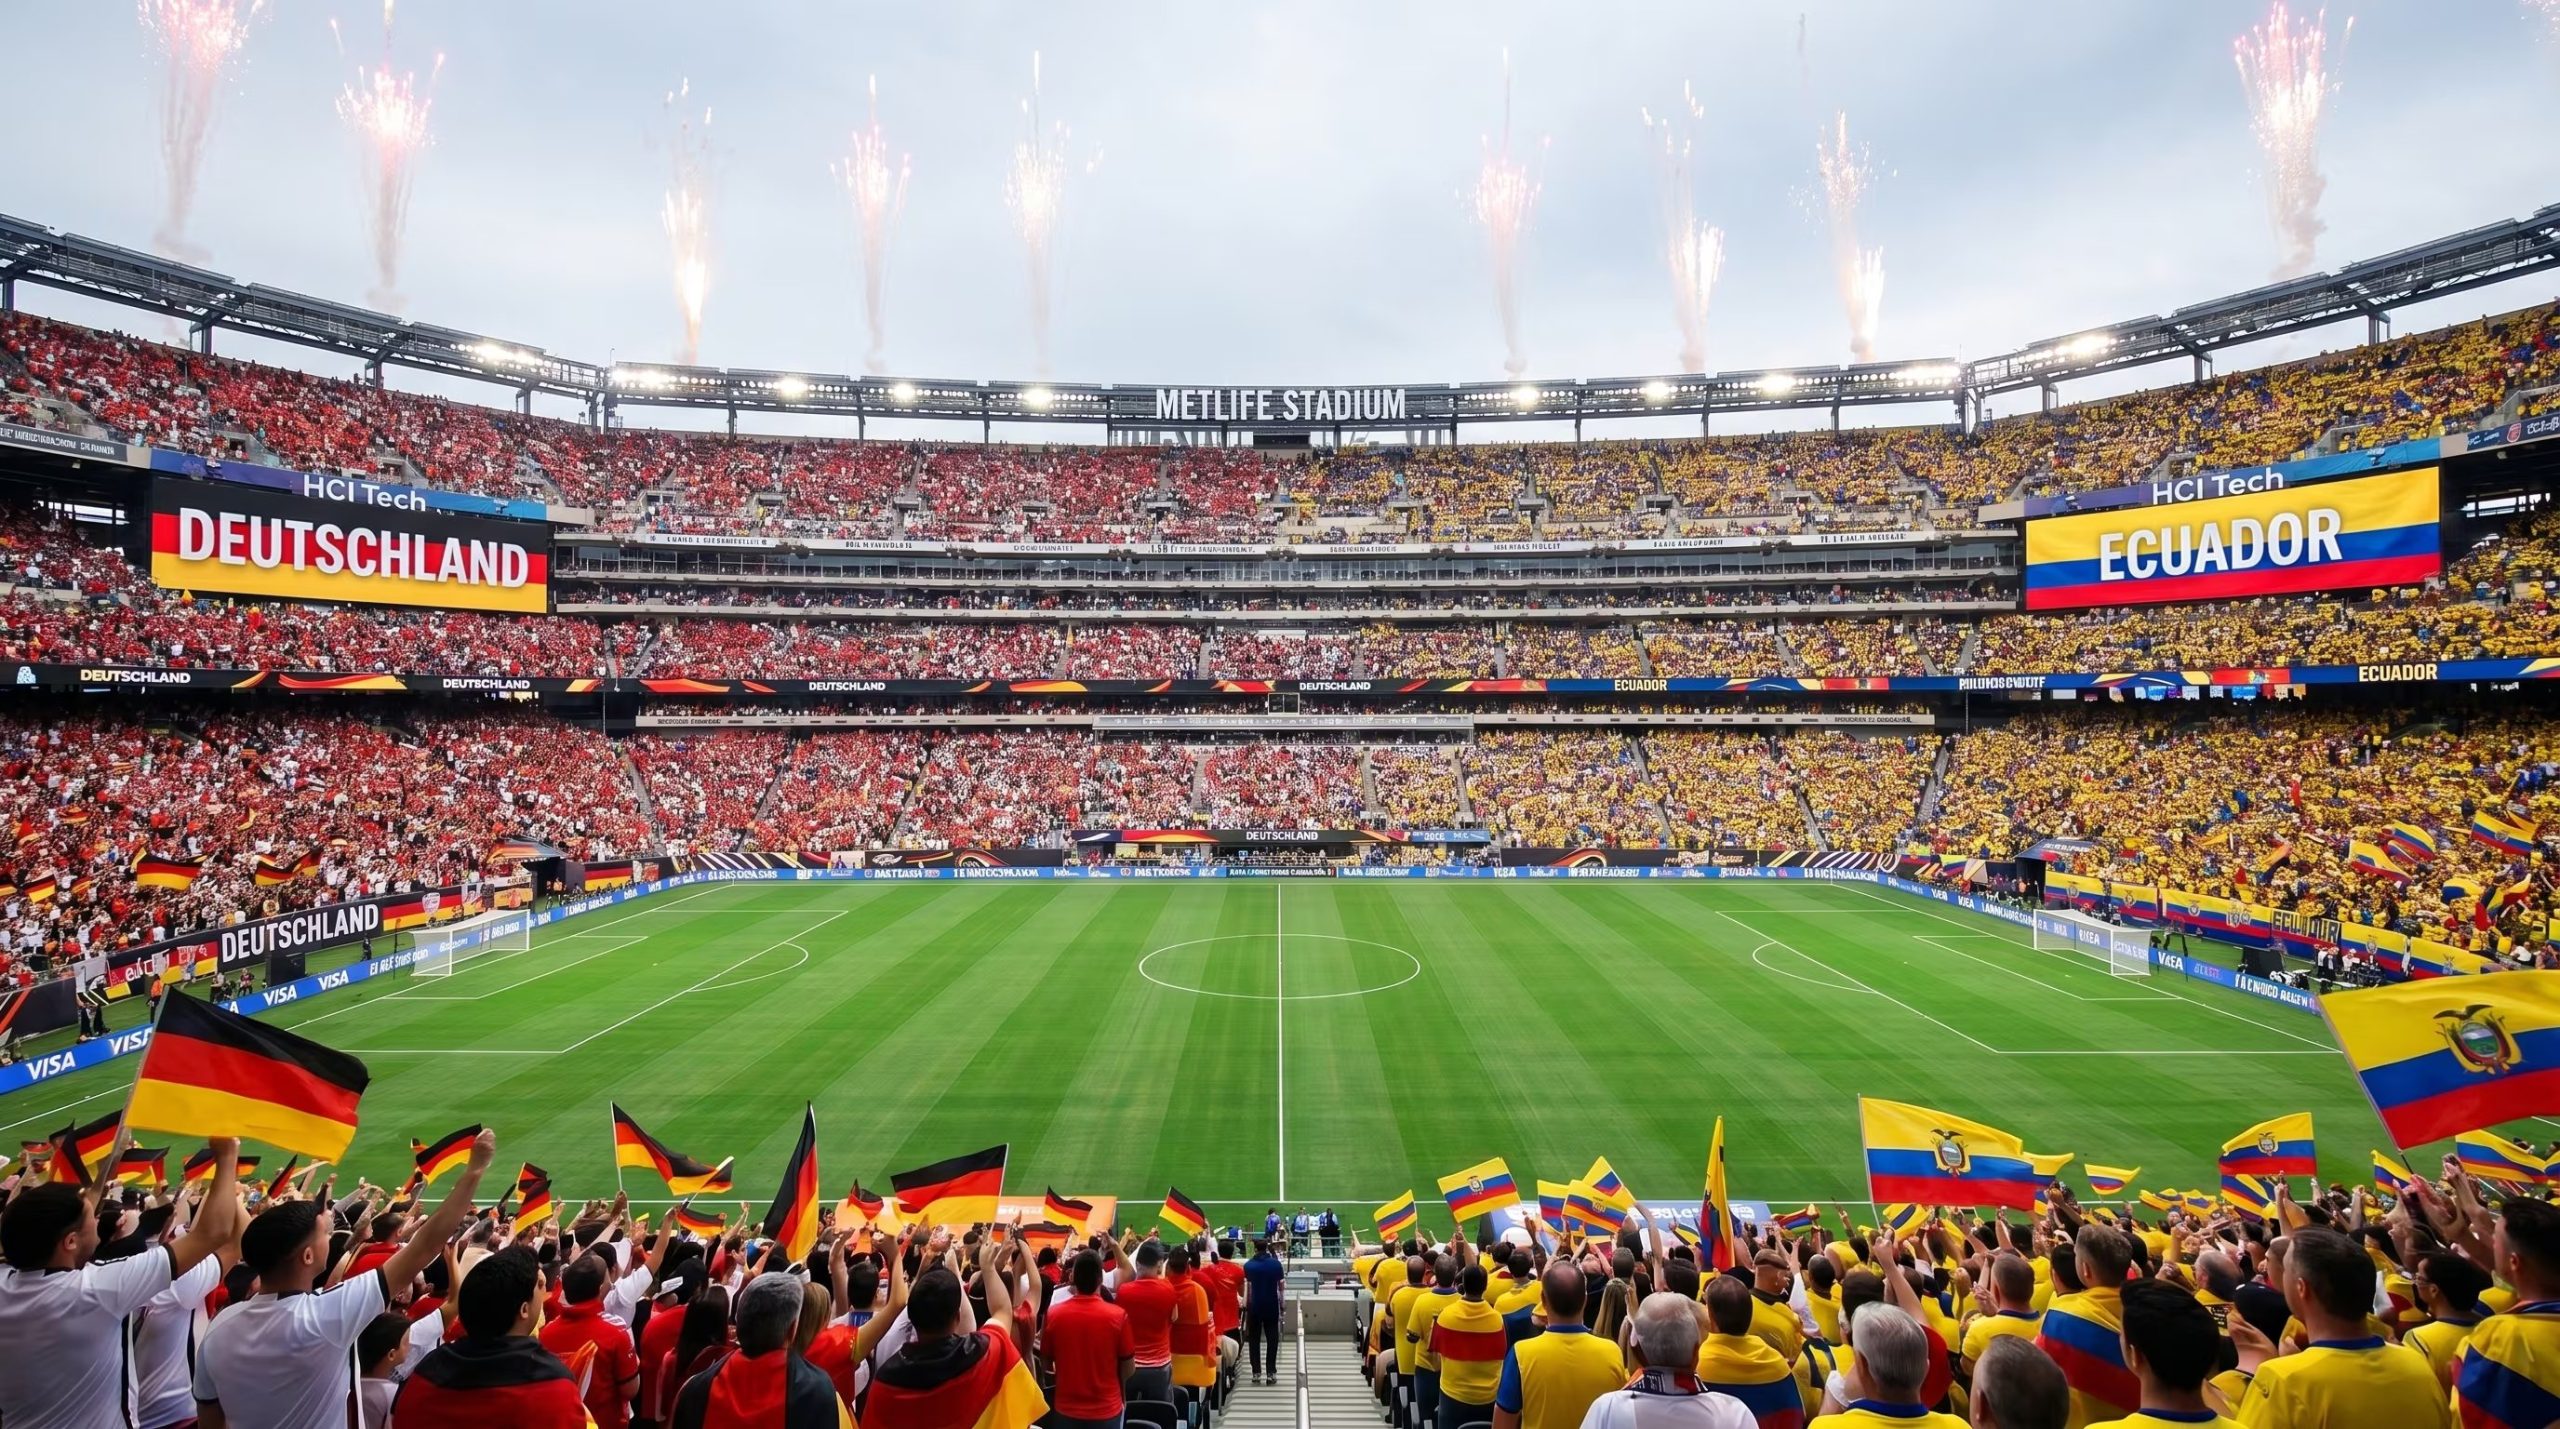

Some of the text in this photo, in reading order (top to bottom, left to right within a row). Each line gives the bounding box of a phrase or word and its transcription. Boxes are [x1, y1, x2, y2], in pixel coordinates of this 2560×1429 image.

[1156, 389, 1406, 421] METLIFE STADIUM
[2211, 467, 2284, 496] Tech
[361, 483, 426, 512] Tech
[179, 507, 529, 587] DEUTSCHLAND
[2100, 508, 2342, 581] ECUADOR
[80, 669, 191, 684] DEUTSCHLAND
[2358, 663, 2438, 682] ECUADOR
[443, 678, 530, 689] DEUTSCHLAND
[809, 682, 886, 691] DEUTSCHLAND
[1300, 682, 1371, 691] DEUTSCHLAND
[1614, 679, 1667, 691] ECUADOR
[1246, 831, 1318, 840] DEUTSCHLAND
[221, 903, 379, 963] DEUTSCHLAND
[318, 969, 349, 991] VISA
[263, 985, 297, 1006] VISA
[26, 1051, 76, 1080] VISA
